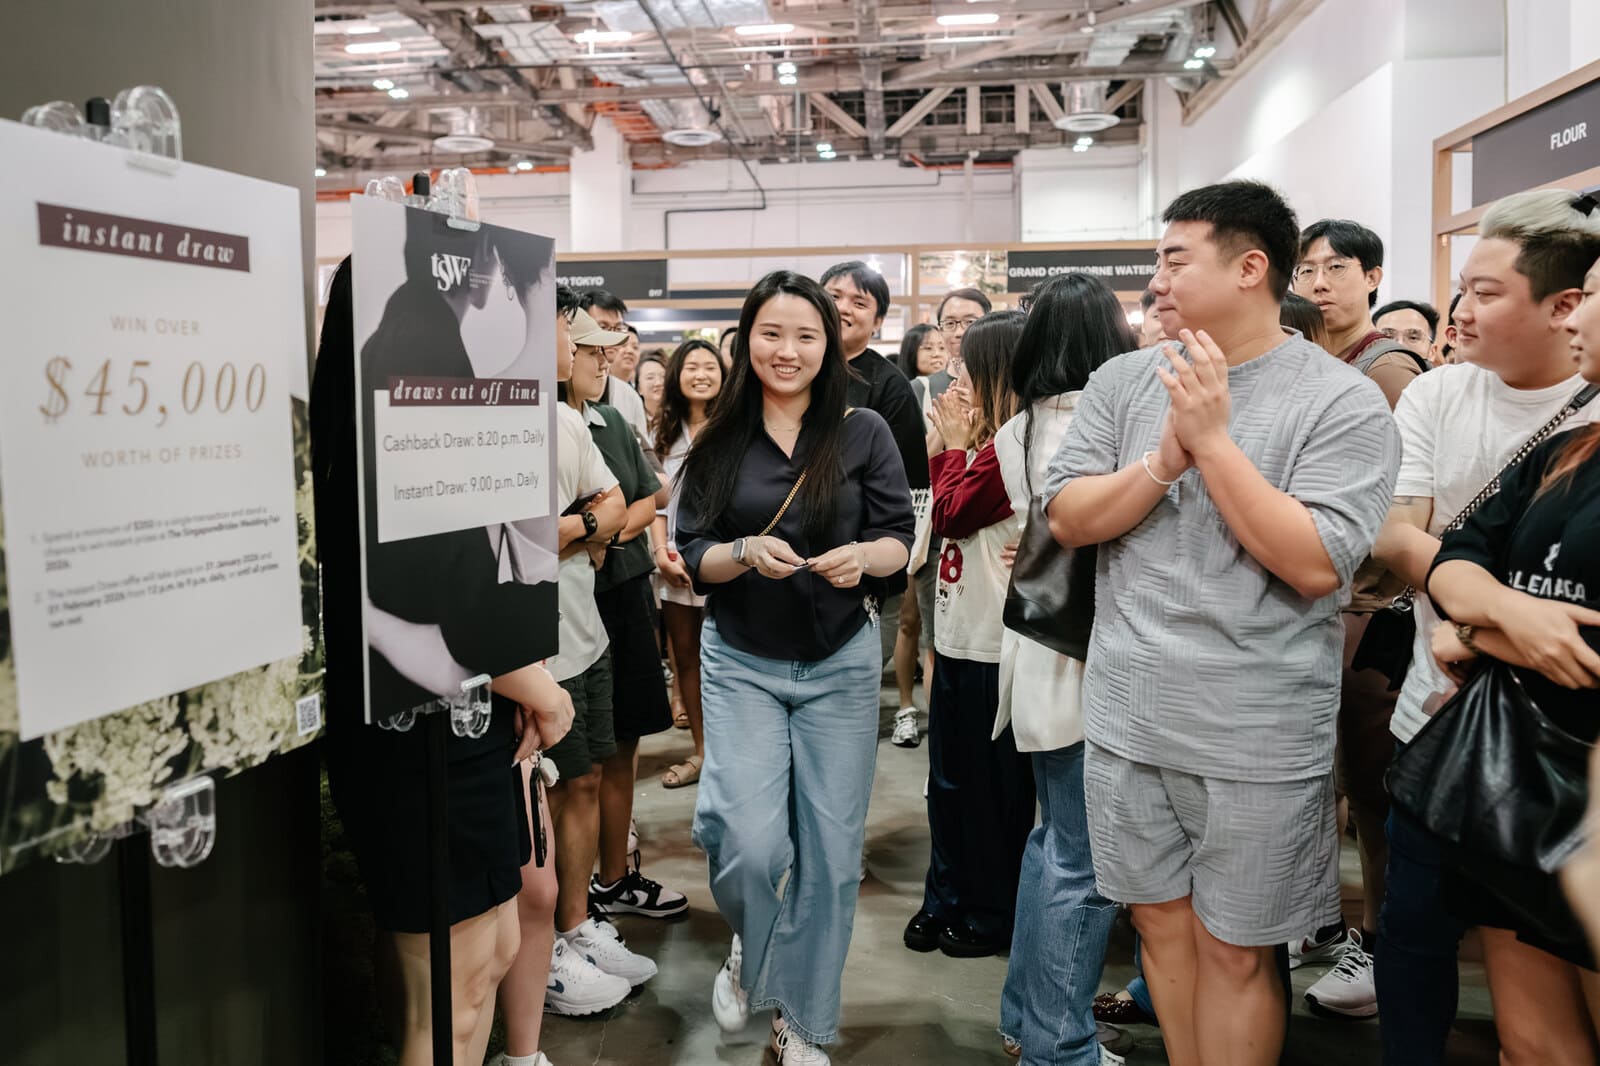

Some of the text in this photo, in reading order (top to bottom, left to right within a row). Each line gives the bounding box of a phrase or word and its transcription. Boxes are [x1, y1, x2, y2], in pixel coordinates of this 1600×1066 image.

[1550, 122, 1587, 150] FLOUR
[62, 213, 236, 264] instant draw
[570, 275, 604, 287] TOKYO
[1009, 266, 1046, 278] GRAND
[110, 316, 200, 336] WIN OVER
[38, 355, 267, 429] $45,000
[393, 379, 537, 405] draws cut off time
[383, 429, 545, 452] Cashback Draw: 8.20 p.m. Daily
[81, 444, 242, 469] WORTH OF PRIZES
[393, 472, 539, 501] Instant Draw: 9.00 p.m. Daily
